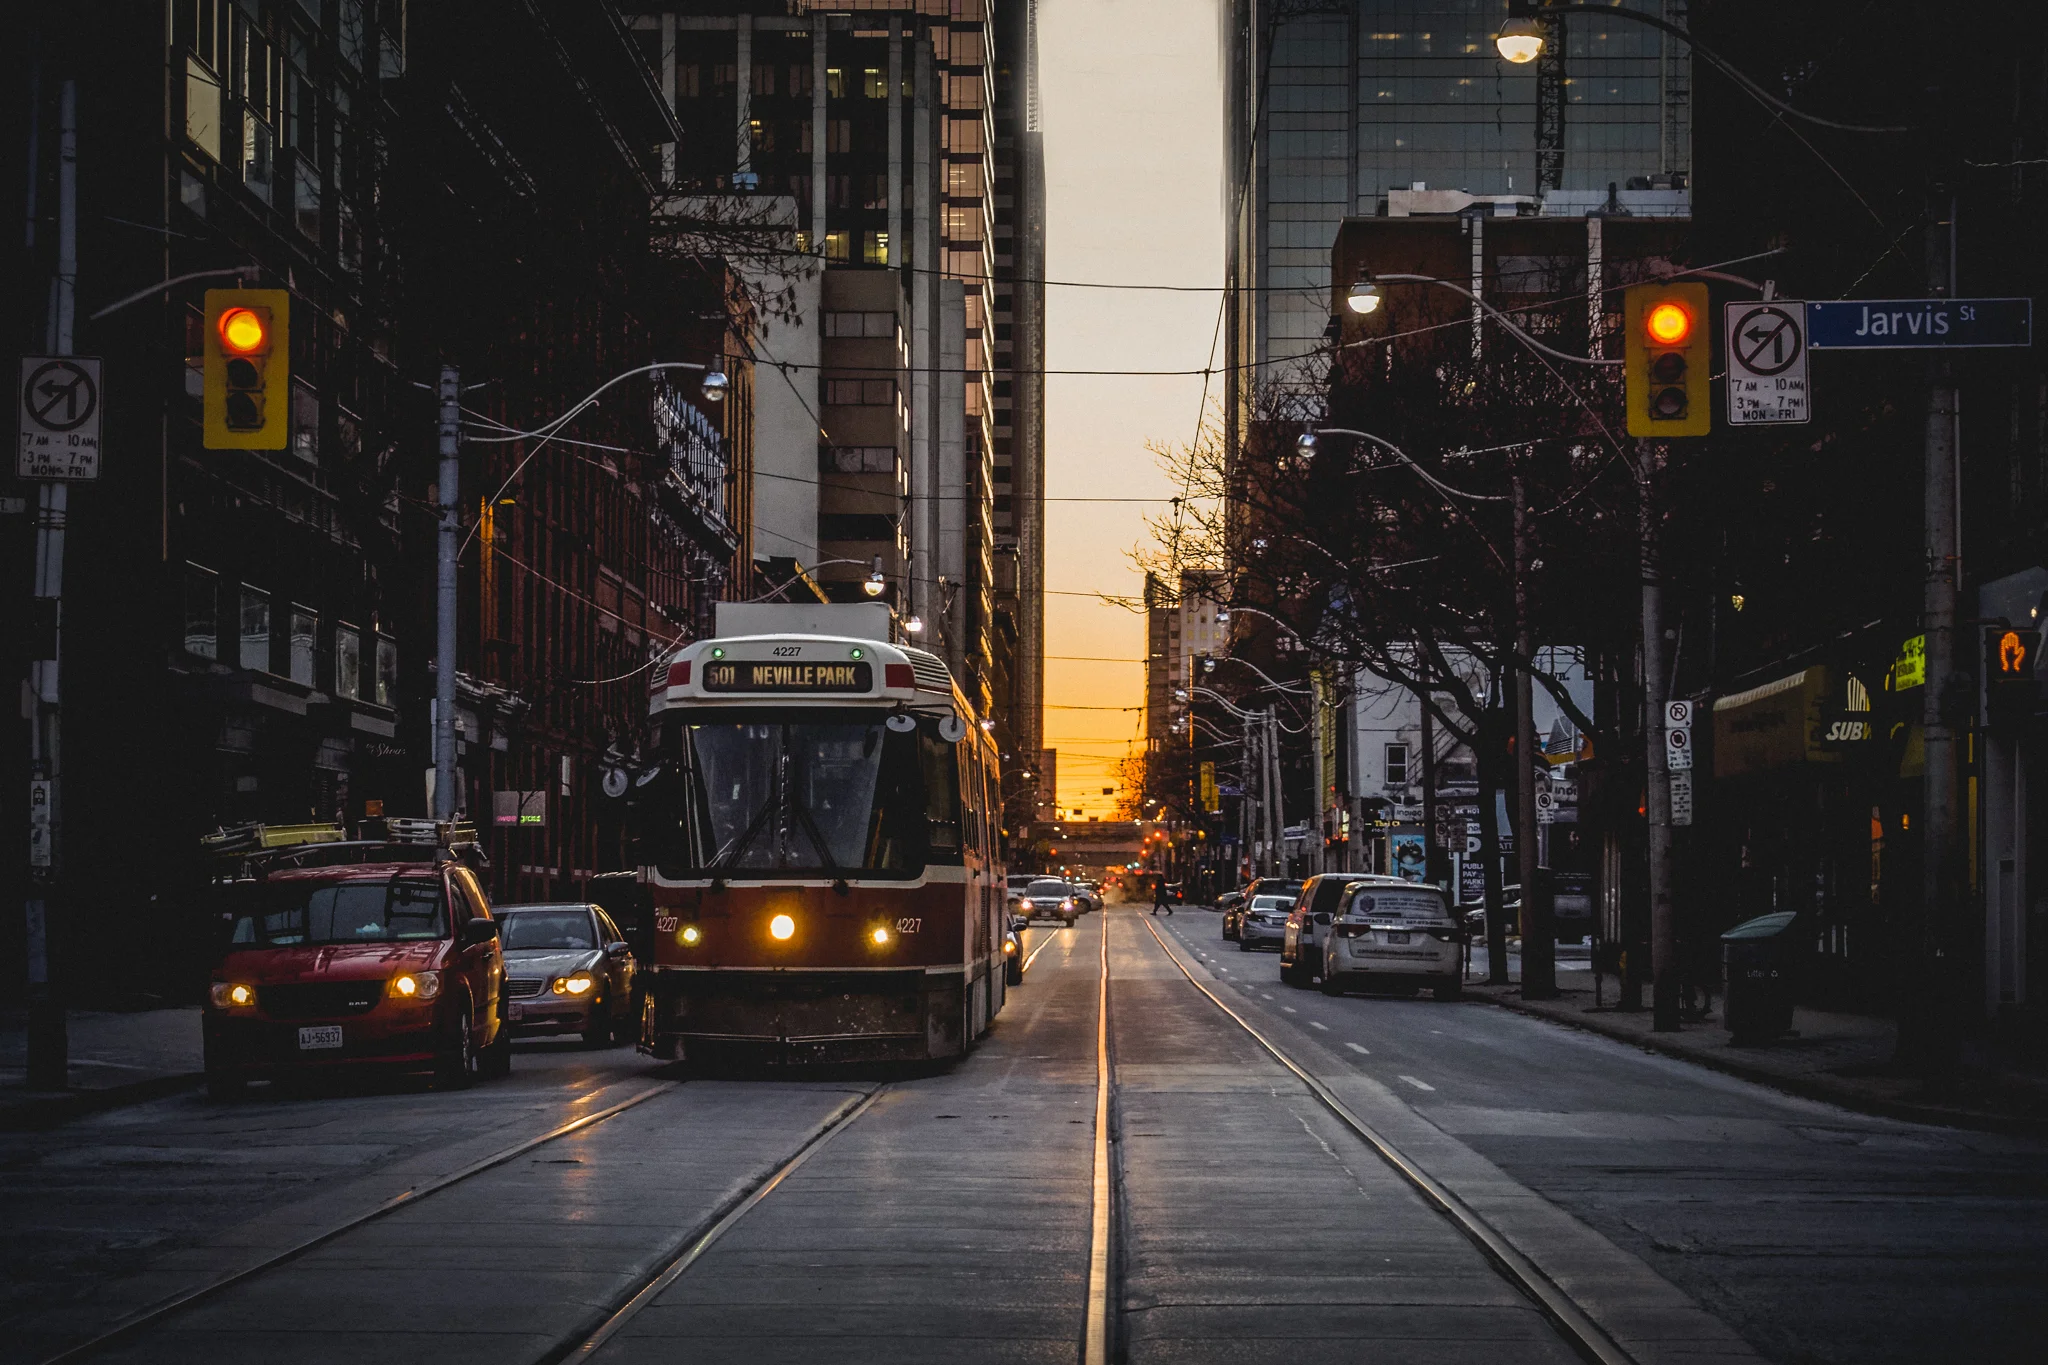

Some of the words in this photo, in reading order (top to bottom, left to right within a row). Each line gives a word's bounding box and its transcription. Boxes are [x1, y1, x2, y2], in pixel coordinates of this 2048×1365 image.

[1855, 304, 1949, 336] Jarvis
[1959, 305, 1976, 321] St
[1735, 380, 1742, 391] 7
[1745, 382, 1757, 391] AM
[1776, 378, 1787, 391] 10
[1789, 381, 1800, 390] AM
[1737, 397, 1744, 409] 3
[1748, 399, 1760, 409] PM
[1777, 396, 1784, 407] 7
[1788, 398, 1800, 408] PM
[1743, 410, 1766, 420] MON
[1778, 409, 1796, 419] FRI
[36, 436, 49, 446] AM
[68, 434, 79, 447] 10
[81, 437, 94, 447] AM
[27, 451, 34, 463] 3
[38, 453, 50, 463] PM
[69, 452, 77, 464] 7
[80, 454, 92, 464] PM
[31, 465, 56, 476] MON
[68, 466, 86, 477] FRI
[772, 646, 802, 657] 4227
[709, 665, 735, 686] 501
[752, 665, 813, 686] NEVILLE
[816, 665, 856, 686] PARK
[1462, 870, 1477, 878] PAY
[656, 916, 678, 932] 4227
[895, 917, 922, 933] 4227
